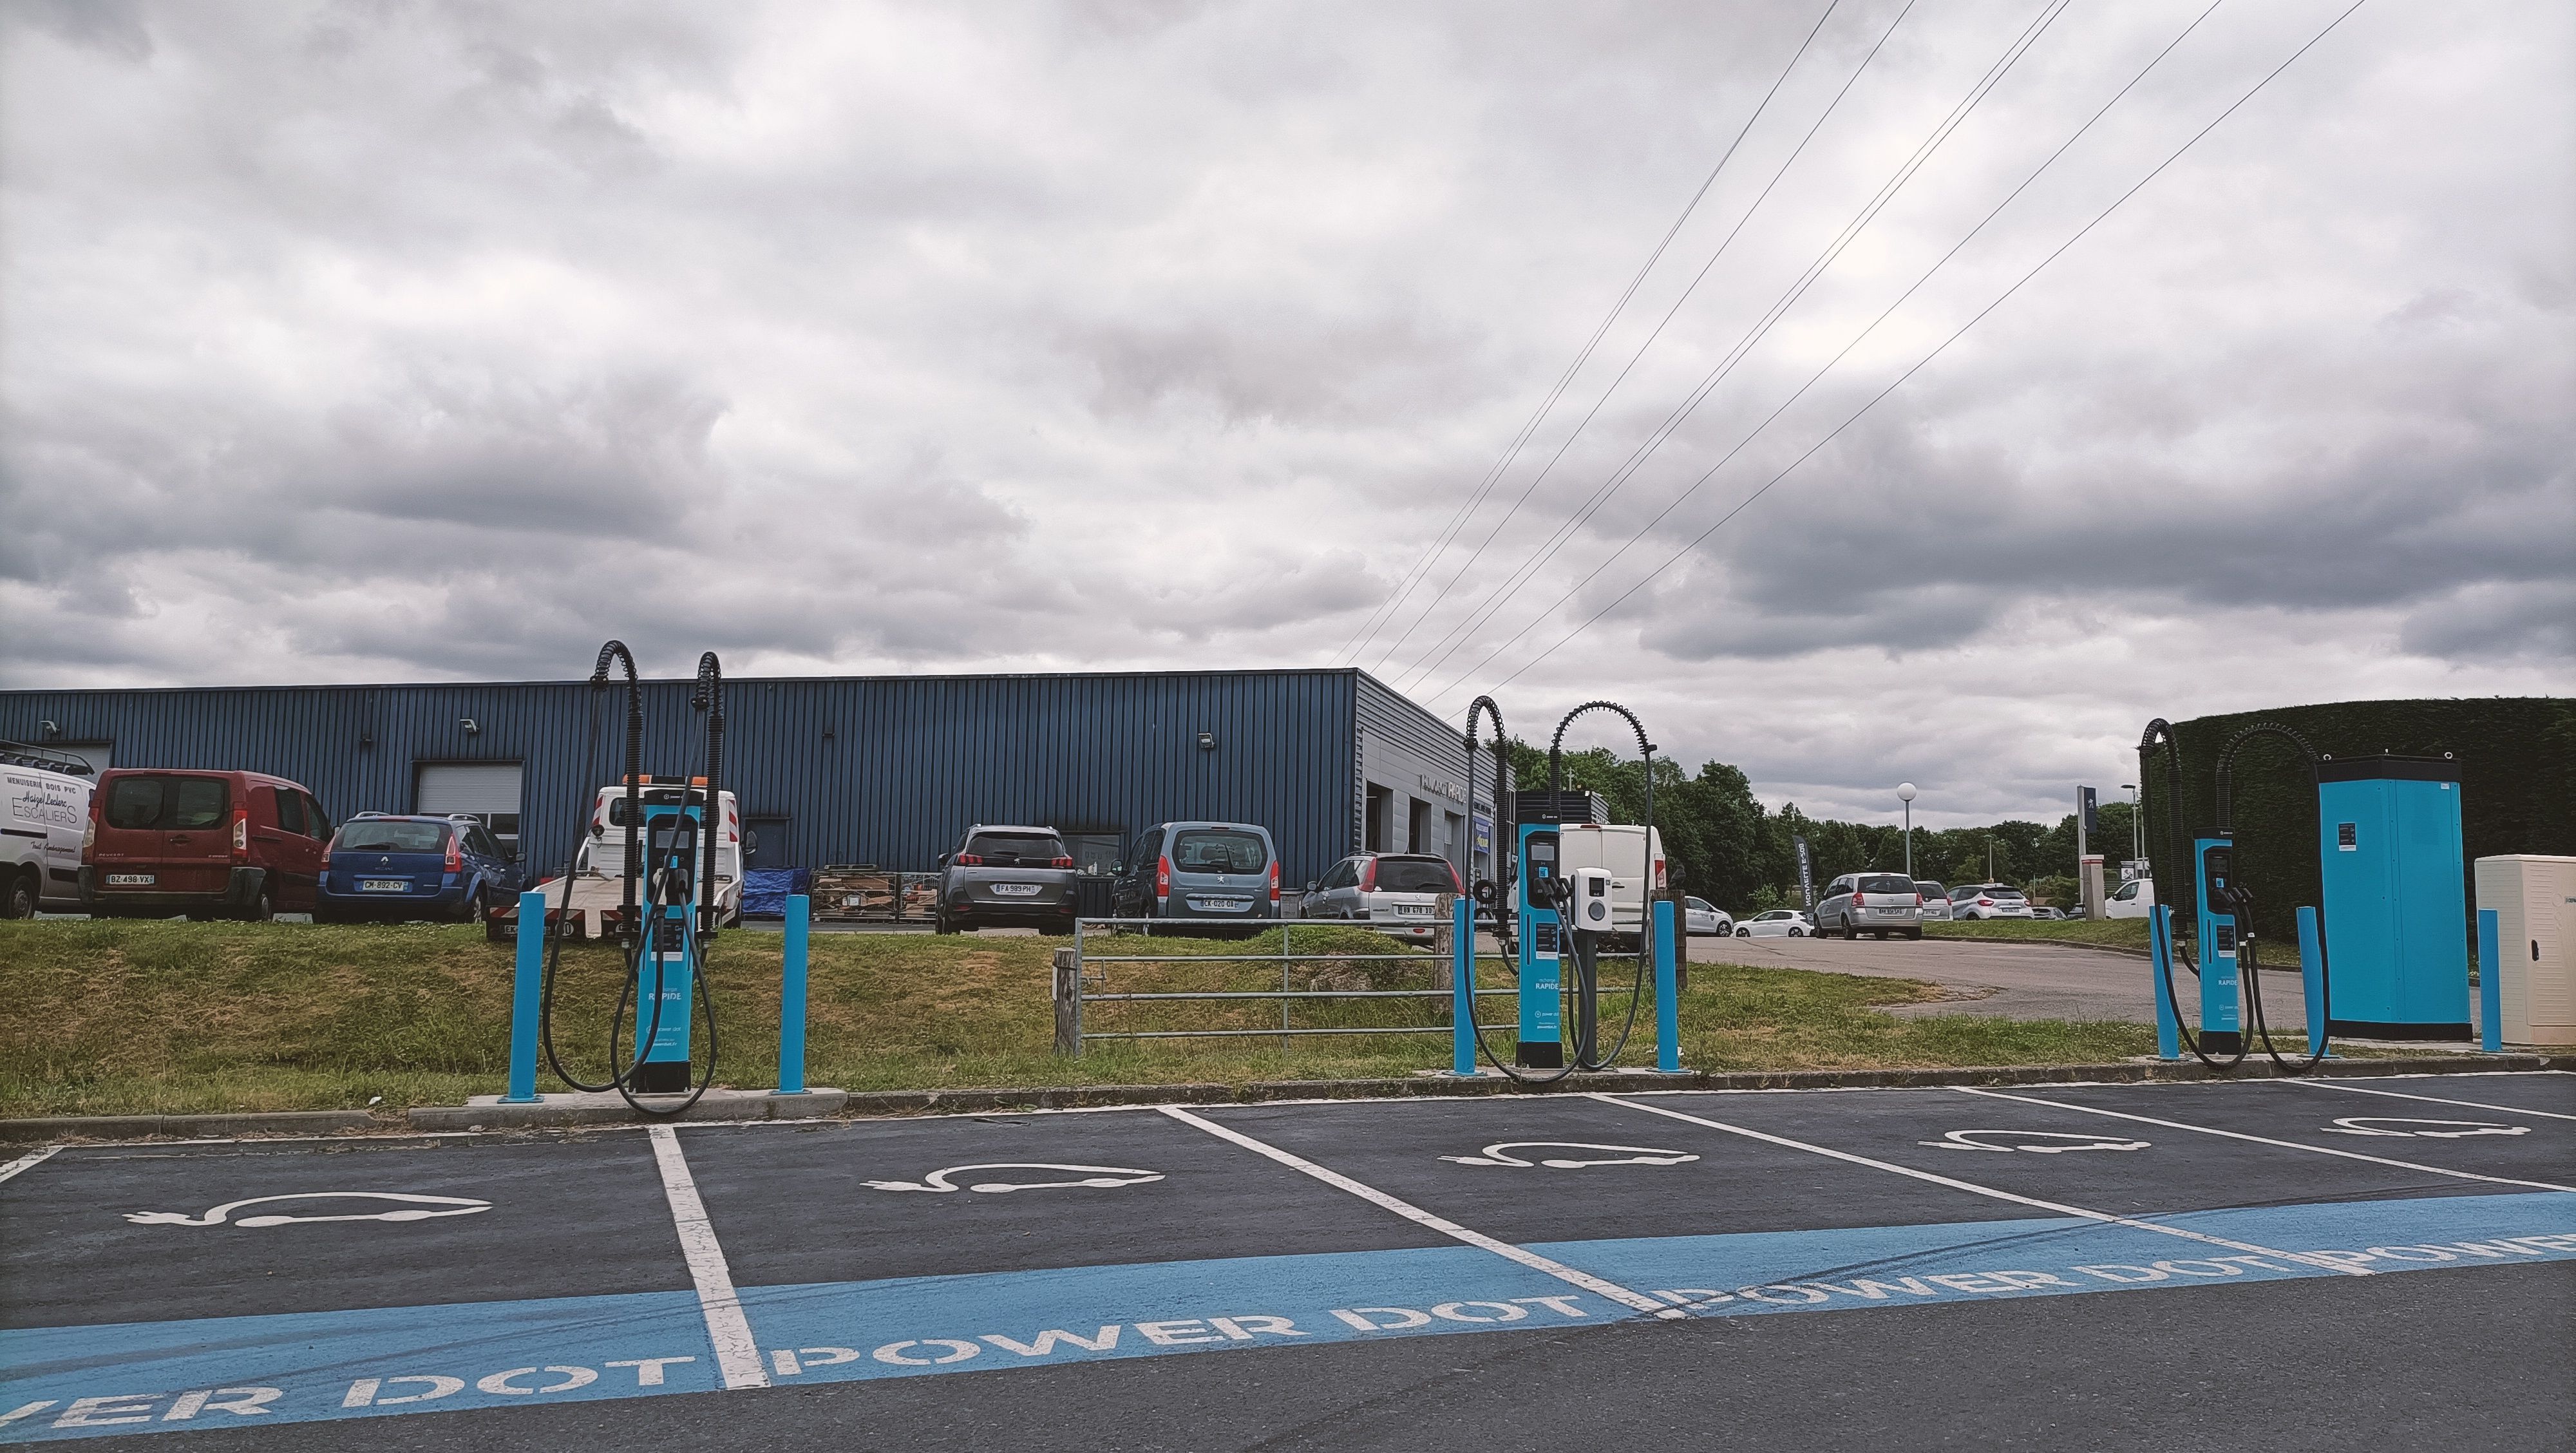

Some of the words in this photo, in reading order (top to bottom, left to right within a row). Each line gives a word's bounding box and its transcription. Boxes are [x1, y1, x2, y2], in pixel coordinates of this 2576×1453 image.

[46, 783, 61, 792] BOIS
[12, 797, 77, 824] ESCALIERS
[2297, 1233, 2576, 1267] POWE
[1649, 1270, 2087, 1310] POWER
[2068, 1255, 2298, 1283] DOT
[771, 1315, 1312, 1376] POWER
[1327, 1295, 1591, 1331] DOT
[341, 1356, 696, 1408] DOT
